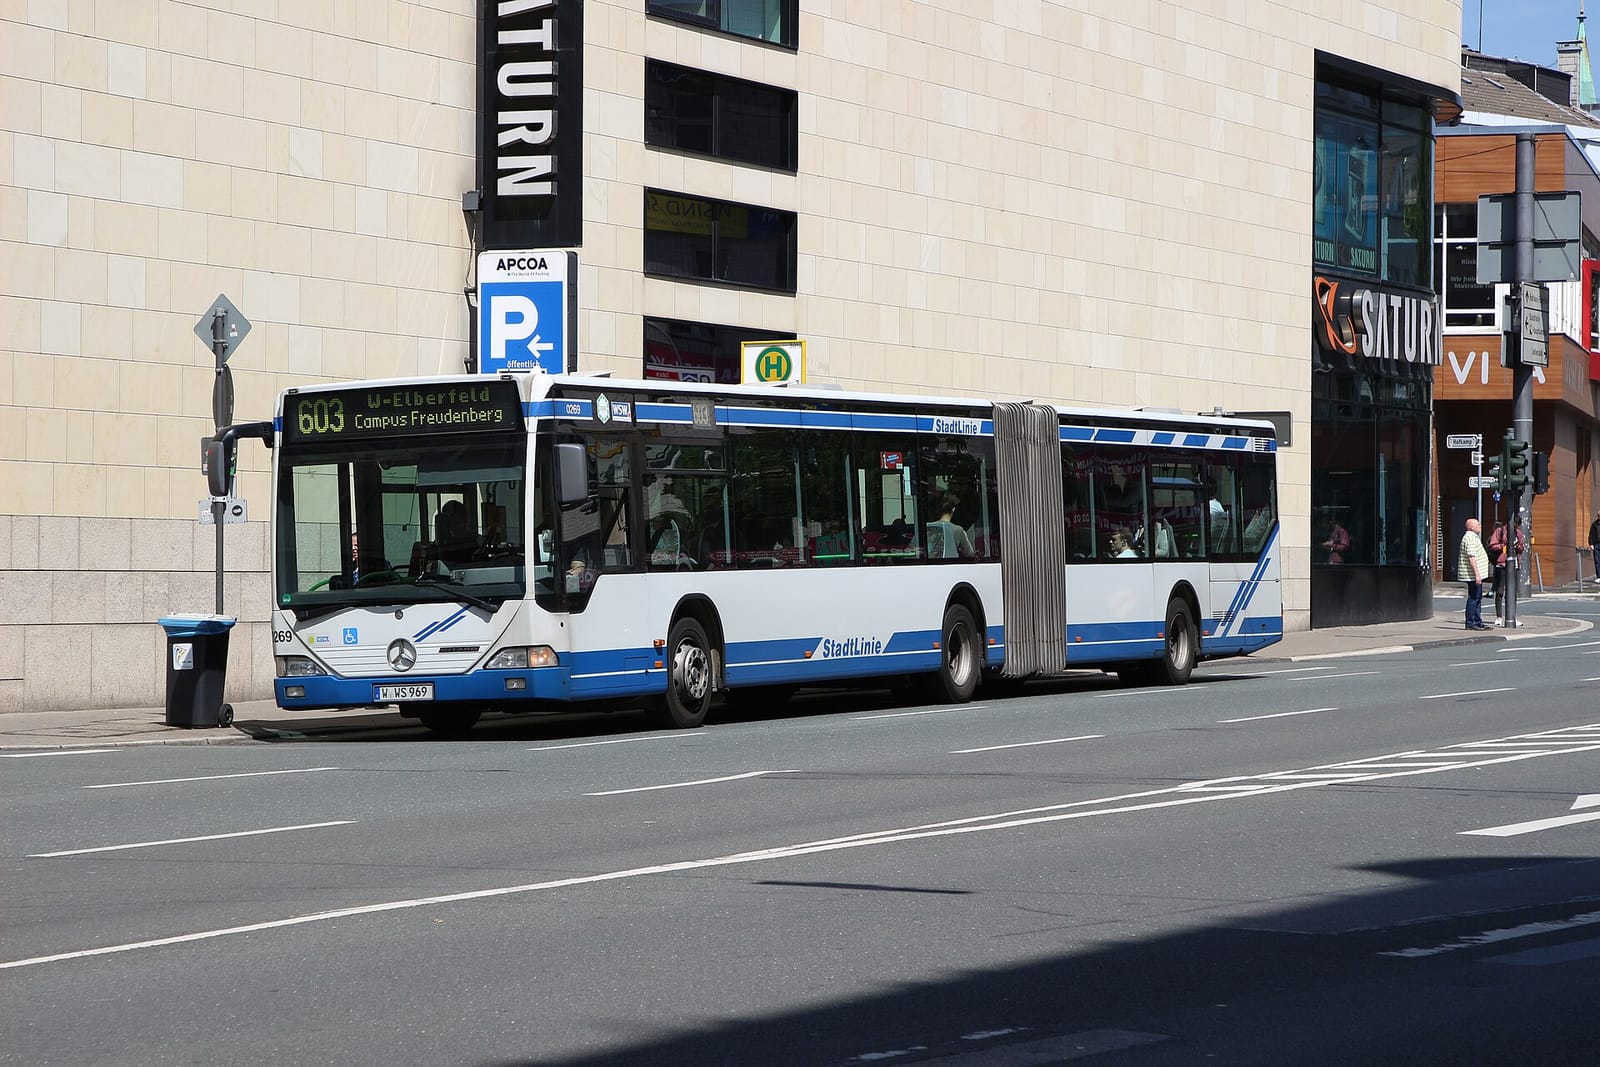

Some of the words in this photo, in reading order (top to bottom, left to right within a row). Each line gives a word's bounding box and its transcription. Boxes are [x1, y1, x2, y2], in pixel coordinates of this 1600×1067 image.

[496, 257, 548, 271] APCOA
[1350, 247, 1375, 270] SATURN
[490, 295, 539, 359] P
[1361, 289, 1443, 366] SATURN
[764, 355, 782, 378] H
[299, 398, 345, 435] 603
[367, 386, 490, 409] W-Elberfeld
[354, 412, 408, 431] Campus
[410, 406, 503, 426] Freudenberg
[565, 404, 581, 415] 0269
[613, 403, 628, 416] WSW
[935, 418, 978, 435] StadtLinie
[822, 636, 882, 658] StadtLinie
[381, 687, 388, 698] W
